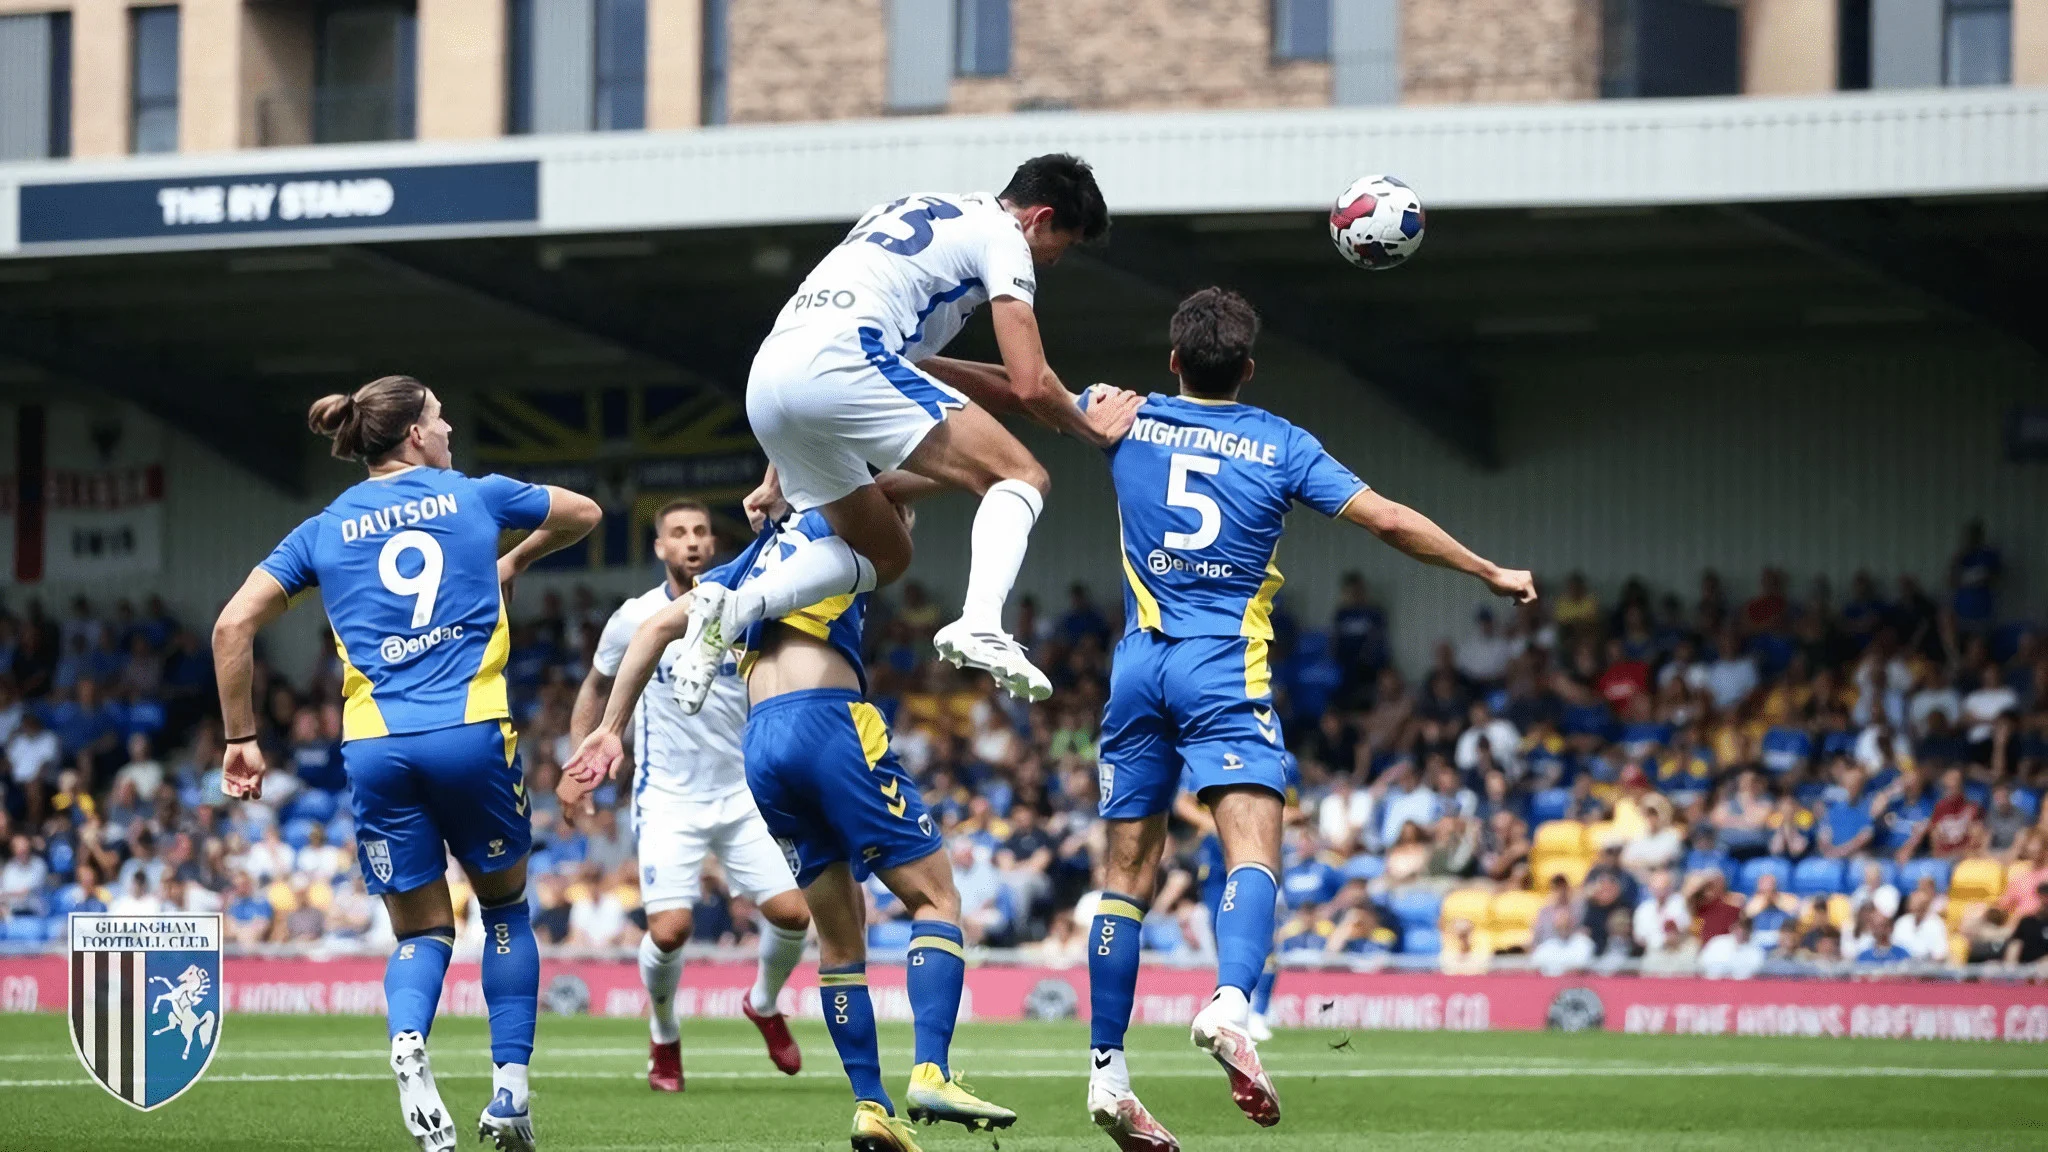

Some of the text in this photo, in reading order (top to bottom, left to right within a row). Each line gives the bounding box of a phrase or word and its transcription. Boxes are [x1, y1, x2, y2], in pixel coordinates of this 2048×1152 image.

[158, 178, 394, 225] THE RY STAND
[1128, 417, 1277, 466] NIGHTINGALE
[341, 493, 458, 543] DAVISON
[1163, 453, 1222, 550] 5
[378, 530, 444, 630] 9
[380, 625, 464, 664] Bendac
